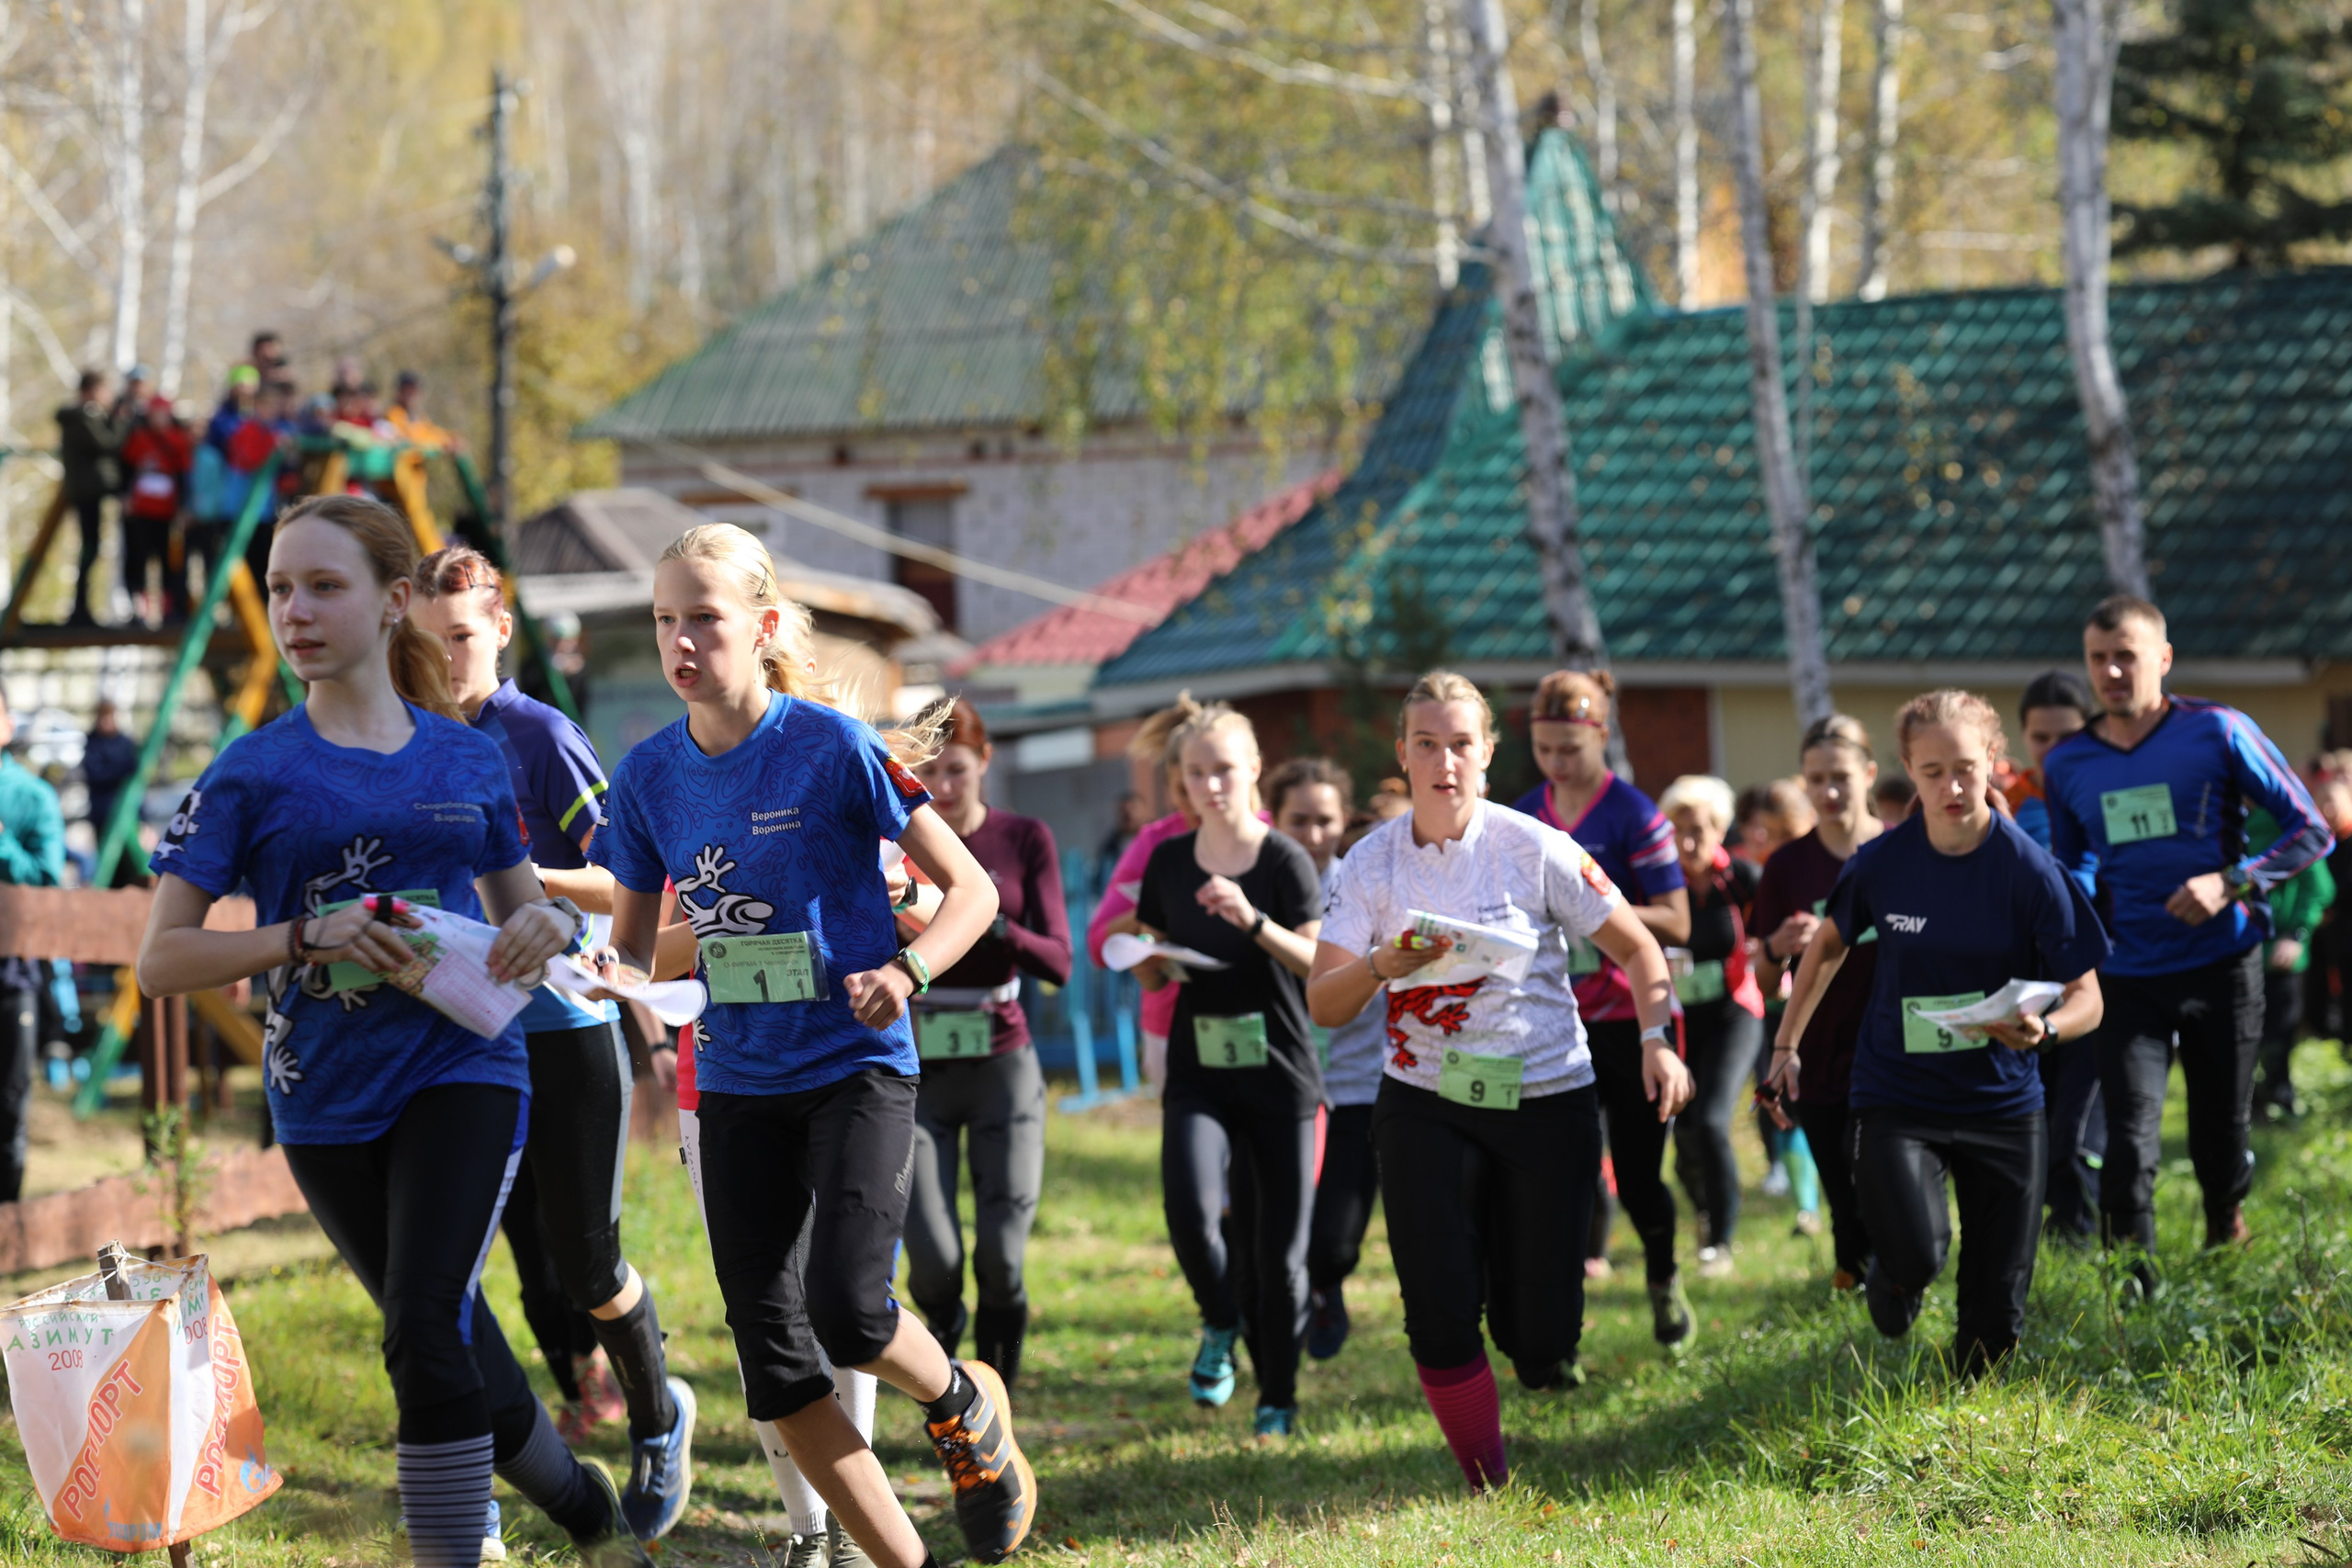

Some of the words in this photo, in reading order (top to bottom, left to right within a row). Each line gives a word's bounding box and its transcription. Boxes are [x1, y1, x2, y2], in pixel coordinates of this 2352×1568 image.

[752, 807, 799, 821] Вероника
[2131, 812, 2151, 836] 11
[752, 820, 801, 836] Воронина
[741, 939, 771, 947] ГОРЯЧАЯ
[772, 937, 803, 946] ДЕСЯТКА
[786, 968, 808, 976] ЭТАП
[753, 969, 770, 1002] 1
[797, 978, 805, 1000] 1
[1224, 1041, 1238, 1064] 3
[1470, 1079, 1486, 1102] 9
[18, 1313, 99, 1329] РОССИЙСКИЙ
[6, 1328, 114, 1351] АЗИМУТ
